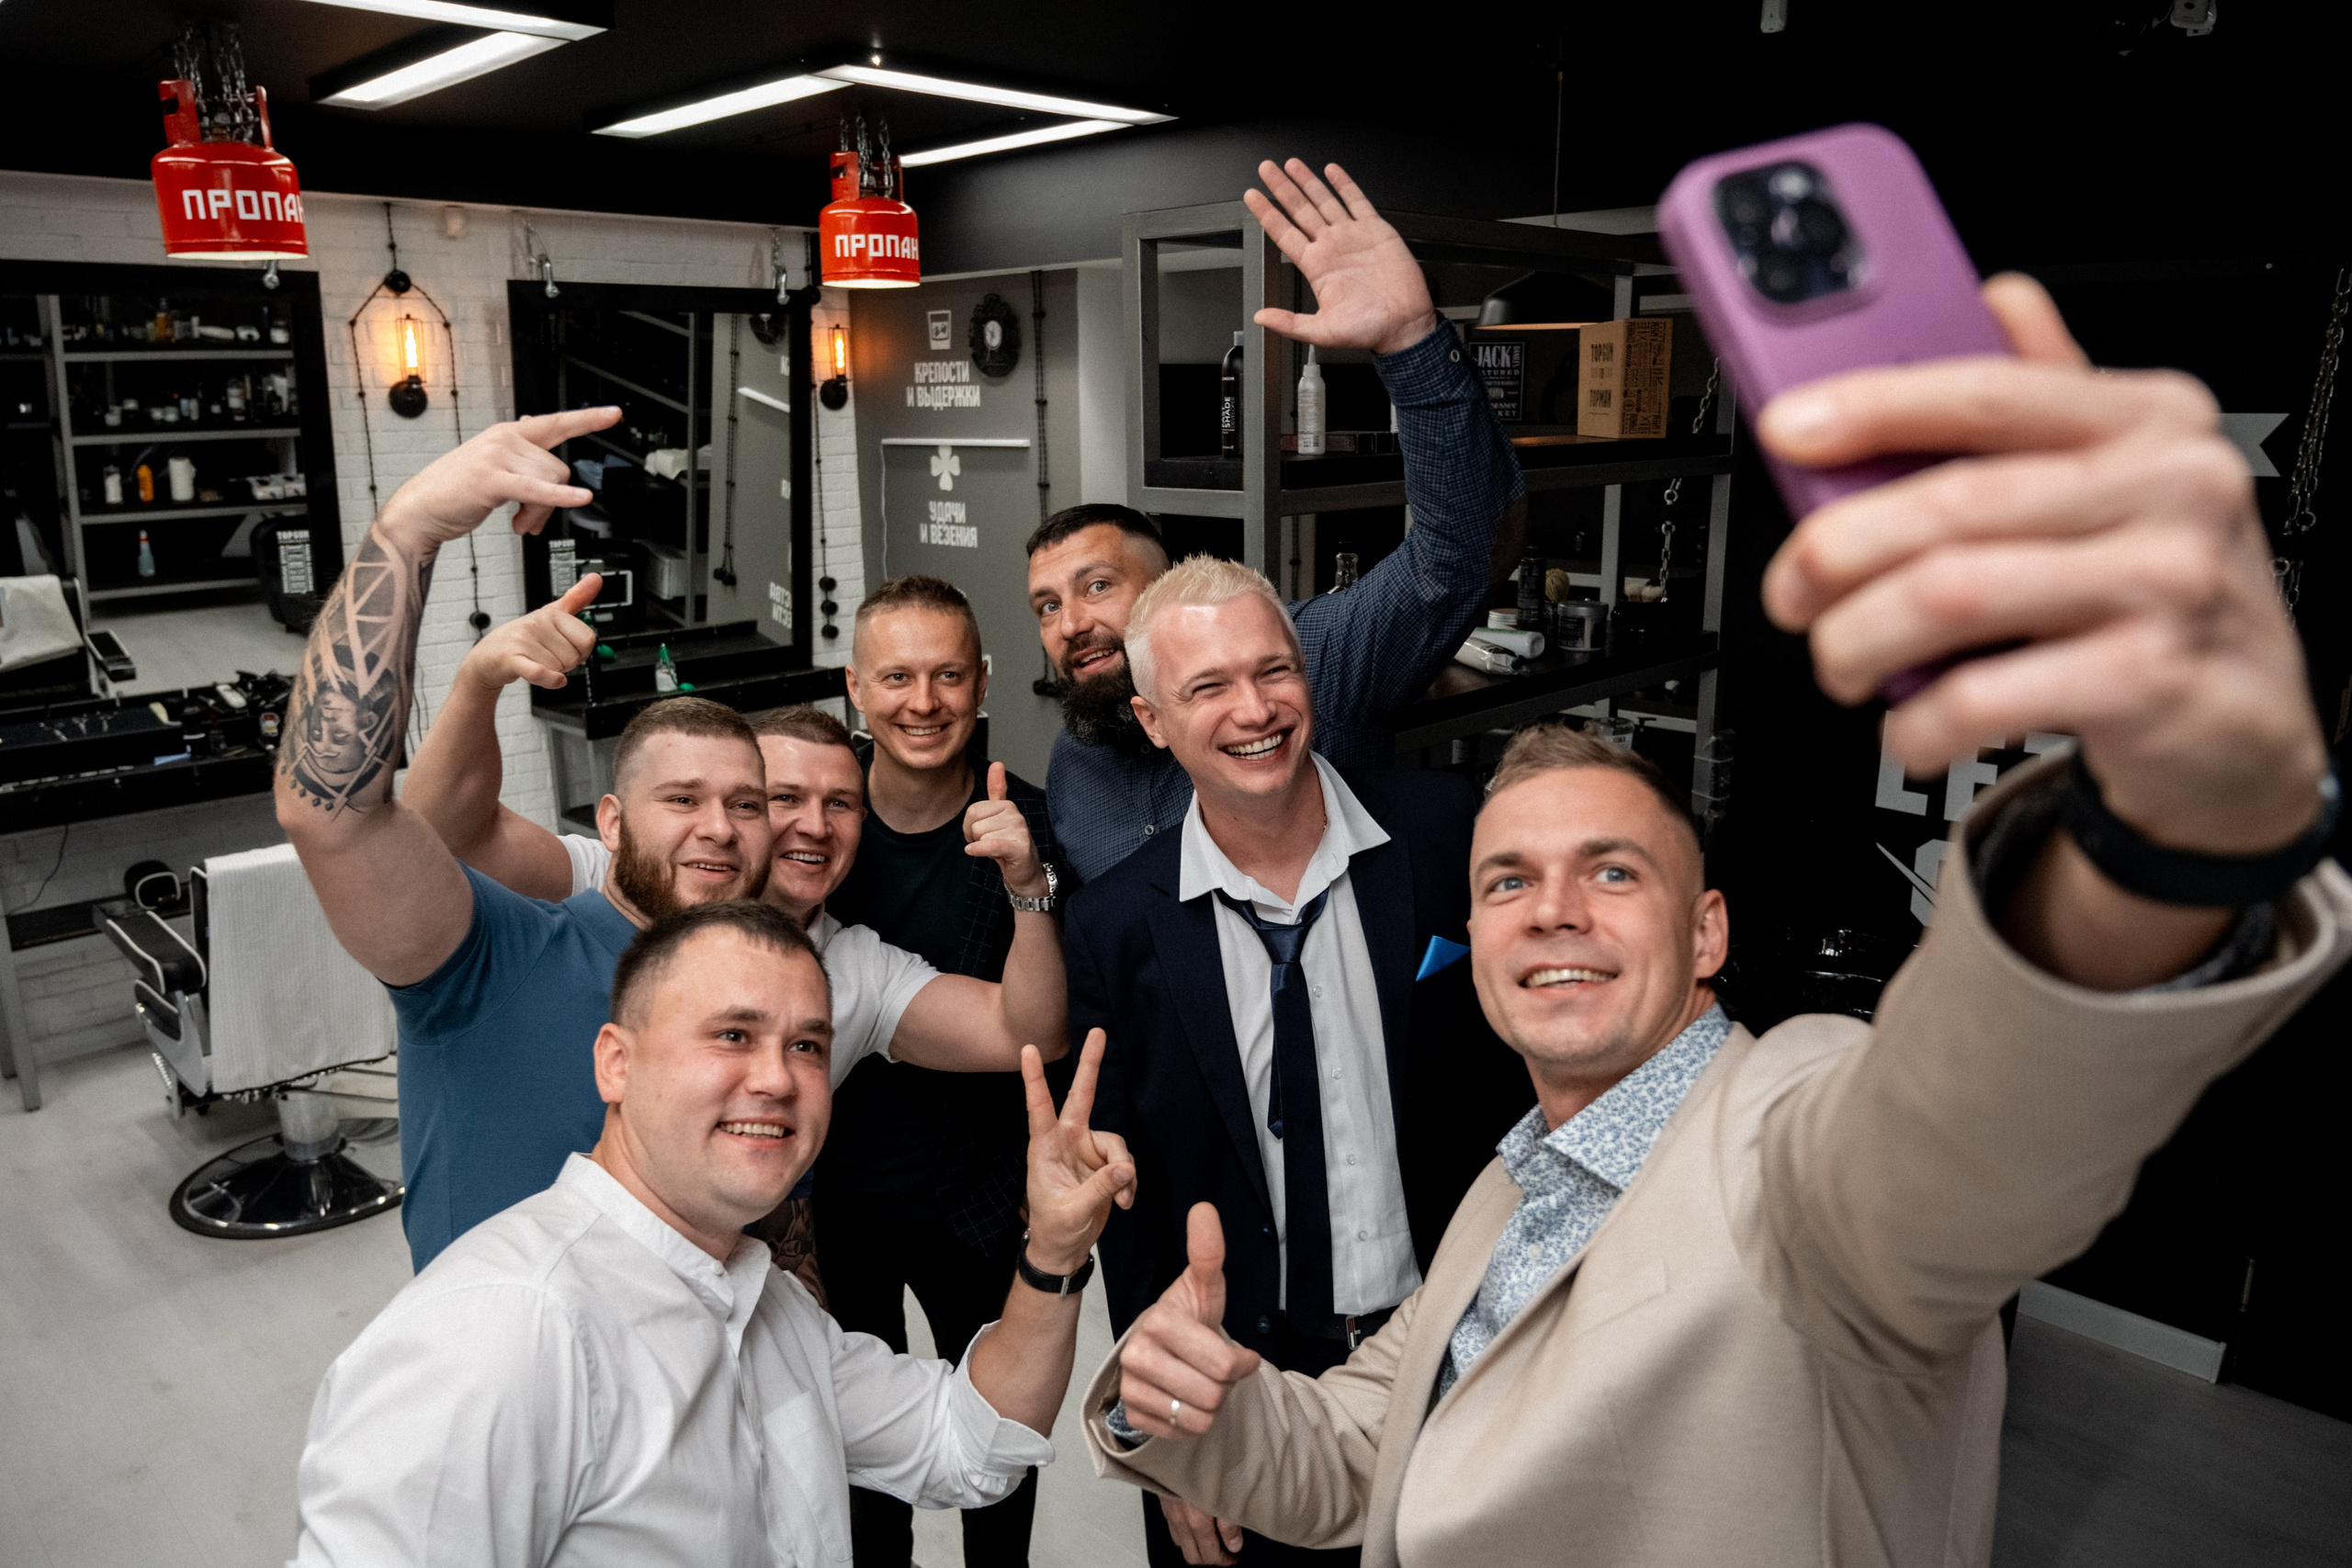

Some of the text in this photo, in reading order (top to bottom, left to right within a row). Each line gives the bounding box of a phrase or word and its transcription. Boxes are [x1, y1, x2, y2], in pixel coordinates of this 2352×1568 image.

[835, 233, 919, 261] ПРОПАН
[1477, 345, 1511, 367] JACK
[914, 360, 970, 384] КРЕПОСТИ
[906, 385, 980, 411] И ВЫДЕРЖКИ
[928, 501, 966, 525] УДАЧИ
[920, 524, 978, 548] И ВЕЗЕНИЯ
